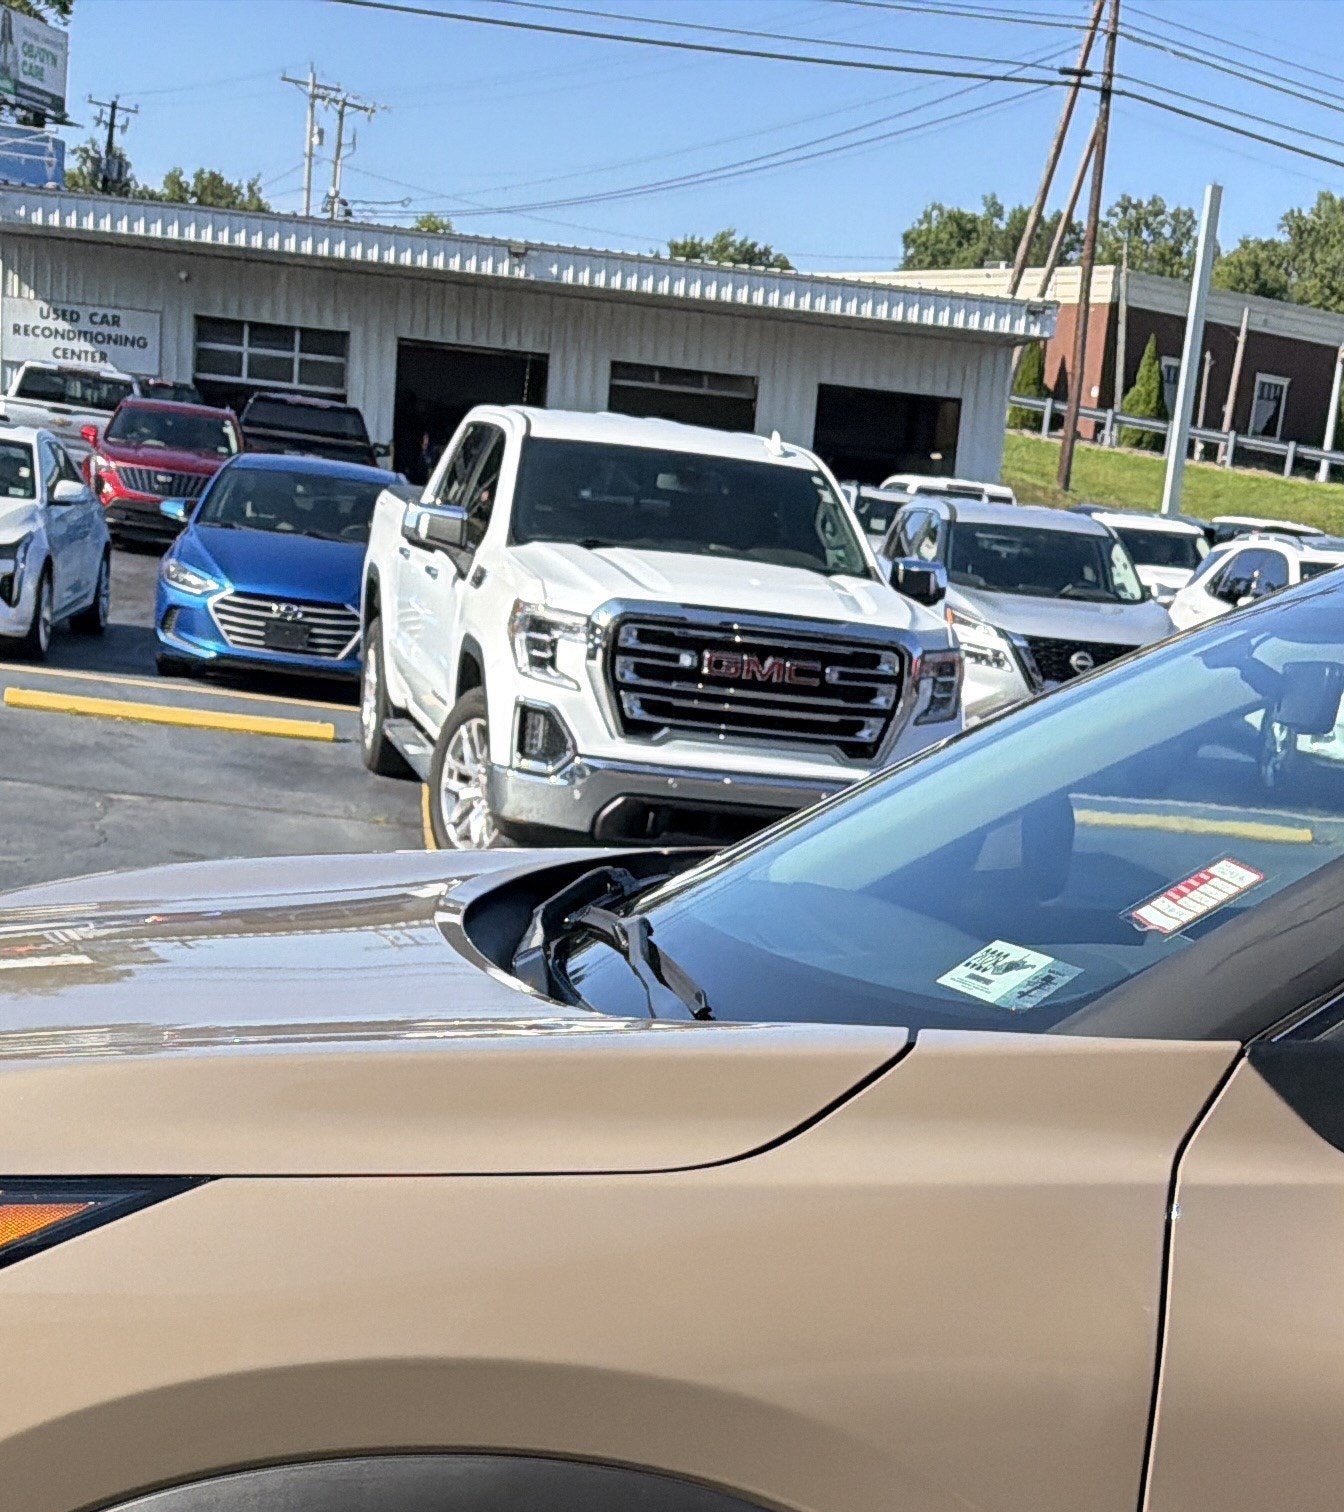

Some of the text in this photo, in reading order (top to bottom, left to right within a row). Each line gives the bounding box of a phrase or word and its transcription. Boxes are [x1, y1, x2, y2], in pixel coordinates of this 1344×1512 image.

[38, 306, 121, 327] USED CAR
[12, 323, 148, 349] RECONDITIONING
[52, 347, 109, 362] CENTER
[701, 649, 822, 688] GMC
